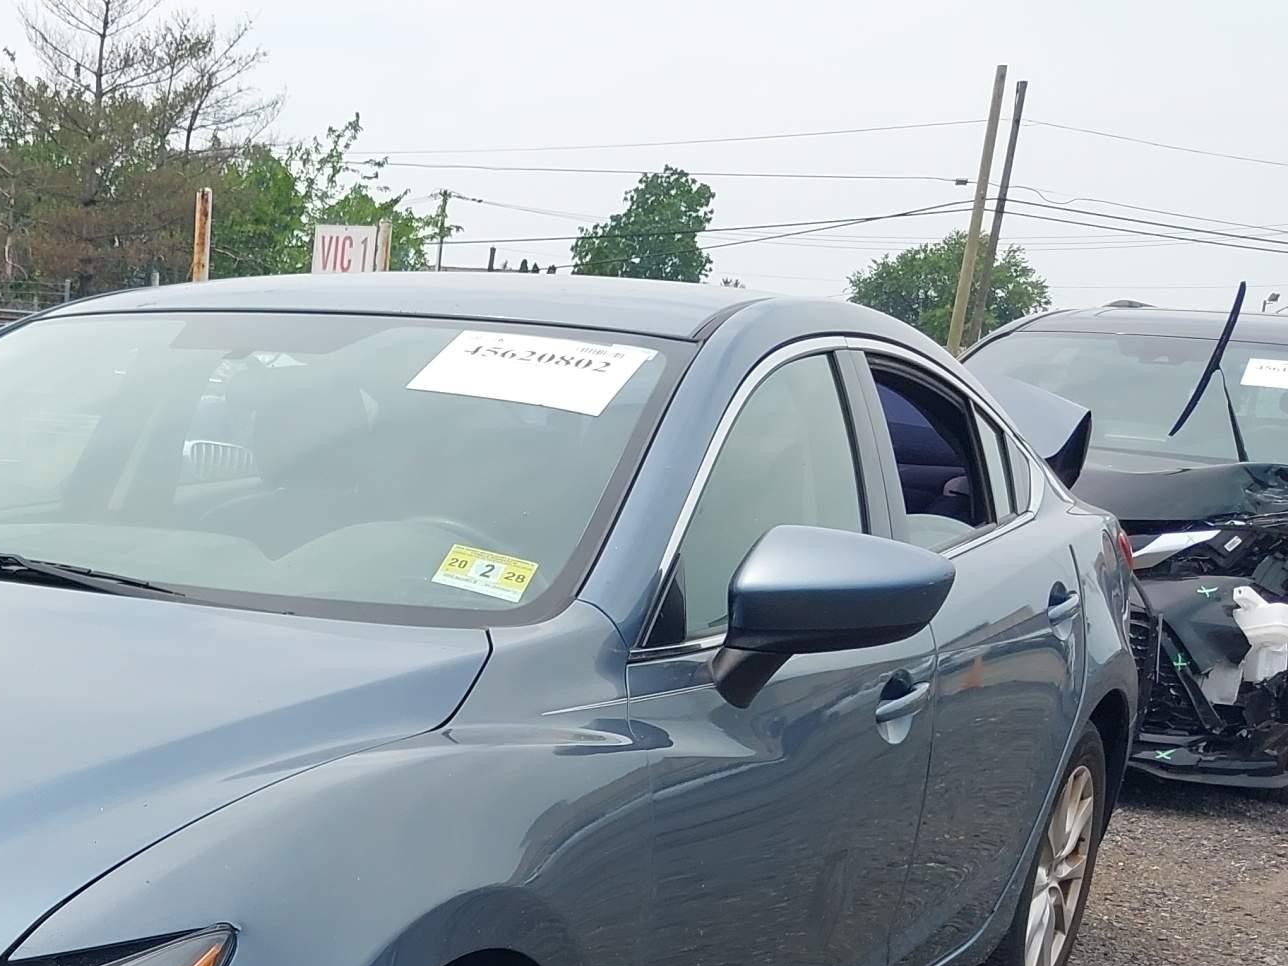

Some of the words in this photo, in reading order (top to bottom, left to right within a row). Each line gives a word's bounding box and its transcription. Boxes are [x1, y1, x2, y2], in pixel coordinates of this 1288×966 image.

[321, 235, 353, 272] VIC
[464, 345, 611, 372] 45620802
[448, 557, 468, 569] 20
[479, 564, 496, 578] 2
[504, 571, 526, 583] 28
